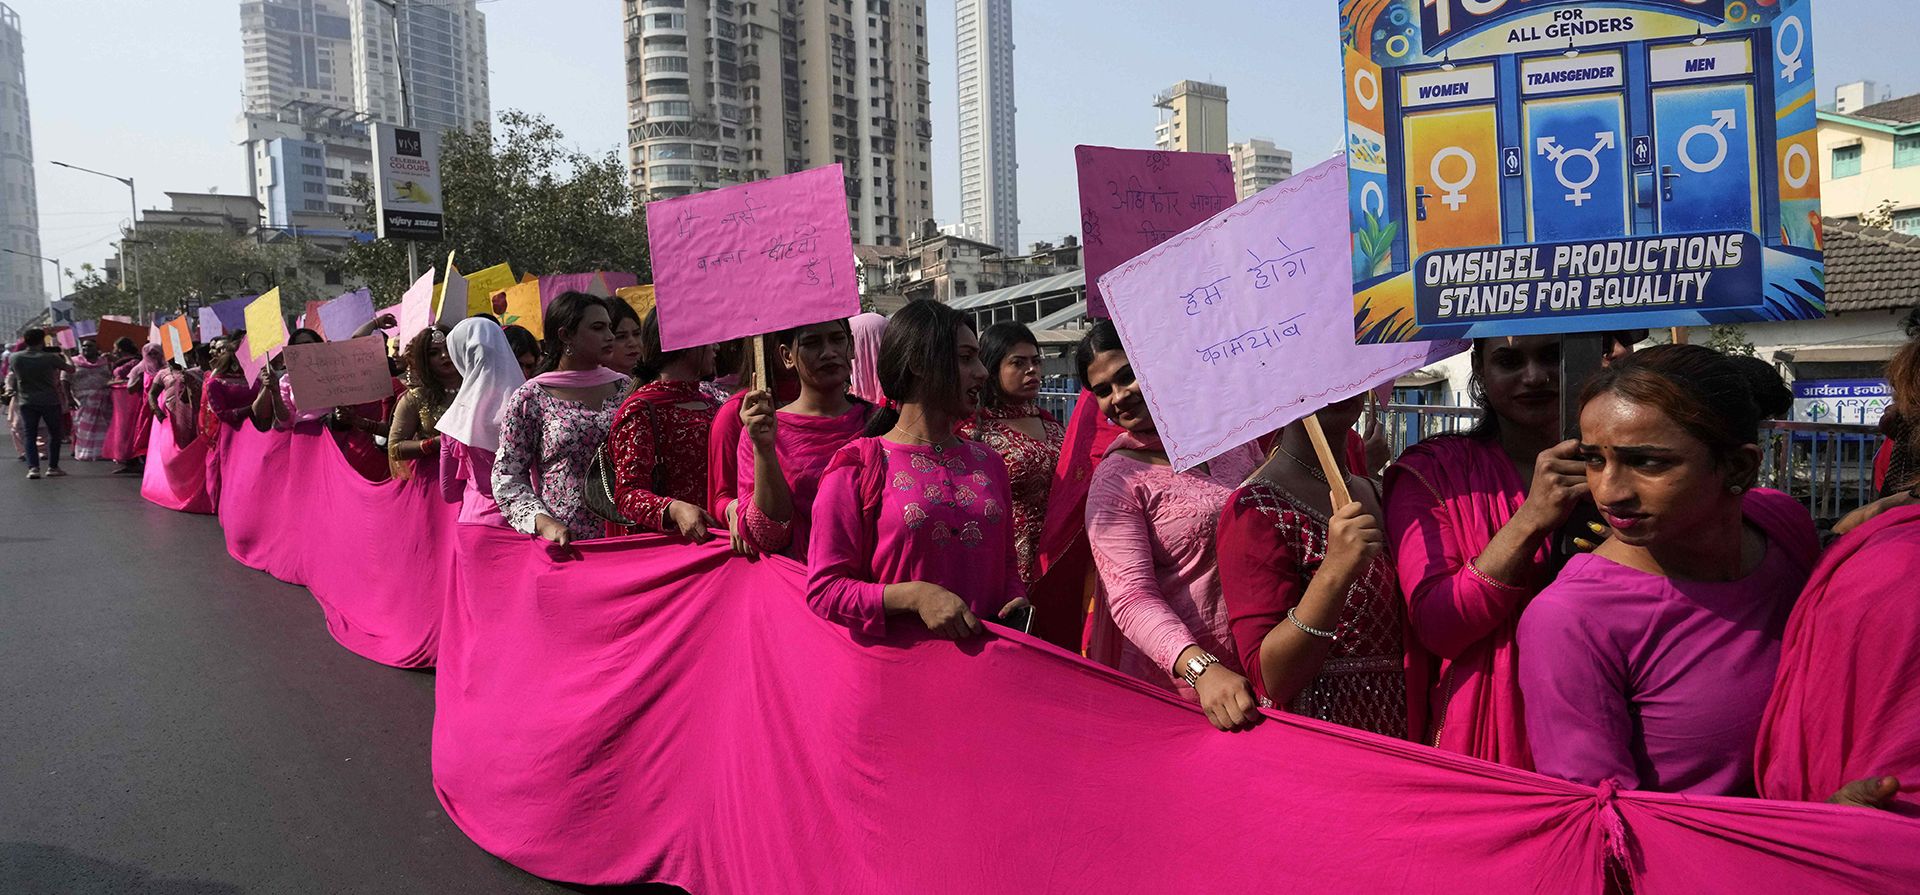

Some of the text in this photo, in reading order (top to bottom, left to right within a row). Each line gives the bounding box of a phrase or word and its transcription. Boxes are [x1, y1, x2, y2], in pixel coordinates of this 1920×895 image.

[1553, 8, 1584, 22] FOR
[1507, 16, 1634, 43] ALL GENDERS
[1684, 57, 1716, 73] MEN
[1526, 66, 1615, 86] TRANSGENDER
[1418, 82, 1470, 99] WOMEN
[389, 156, 429, 166] CELEBRATE
[389, 162, 431, 172] COLOURS
[1424, 233, 1744, 287] OMSHEEL PRODUCTIONS
[1180, 276, 1231, 315] हम
[1437, 271, 1711, 318] STANDS FOR EQUALITY
